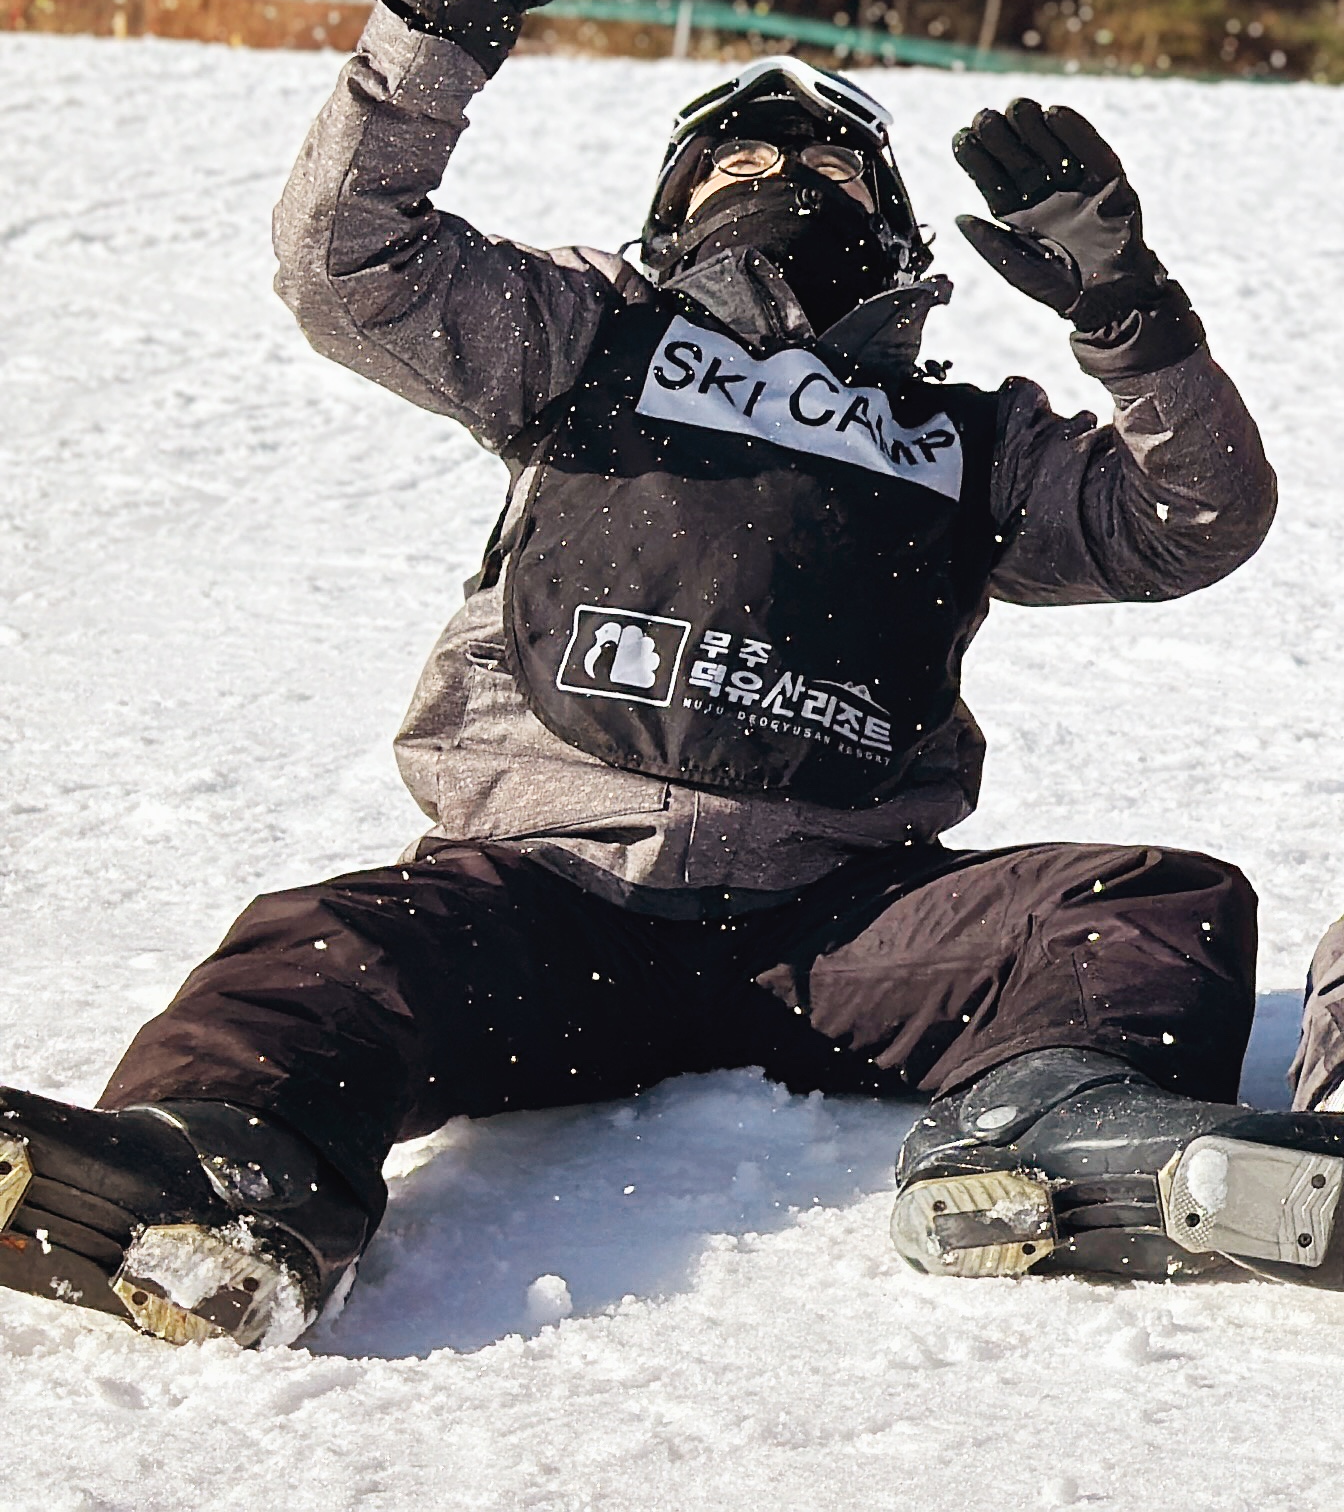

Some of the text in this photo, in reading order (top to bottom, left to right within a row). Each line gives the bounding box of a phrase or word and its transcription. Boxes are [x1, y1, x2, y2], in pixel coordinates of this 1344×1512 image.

[654, 340, 956, 466] SKI CAMP
[688, 659, 893, 752] 덕유산리조트
